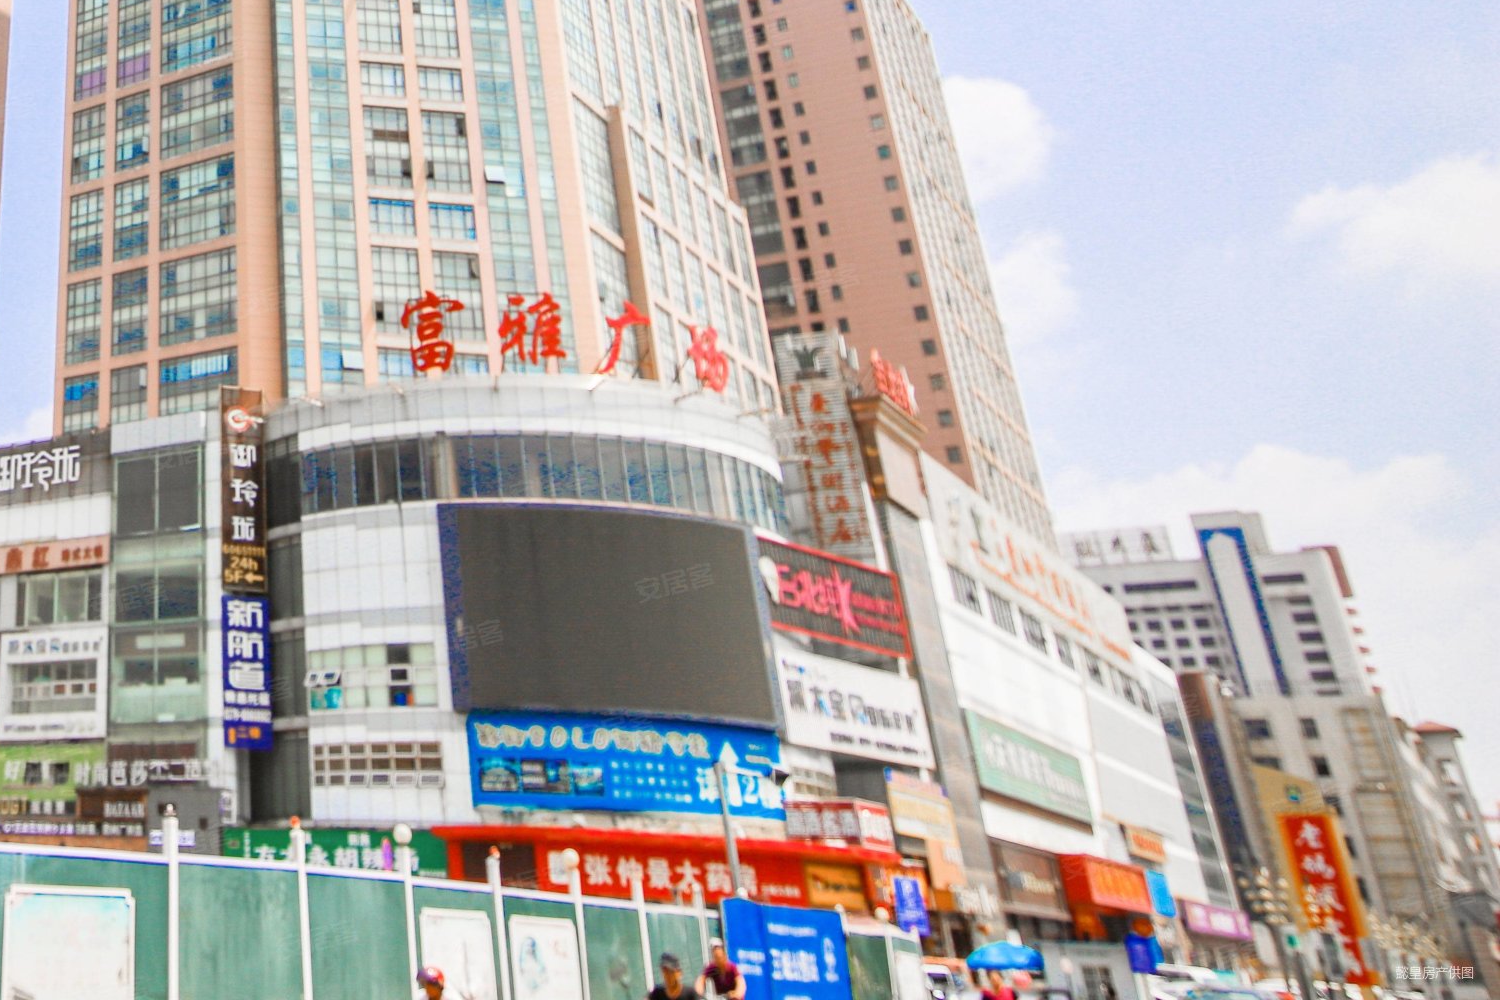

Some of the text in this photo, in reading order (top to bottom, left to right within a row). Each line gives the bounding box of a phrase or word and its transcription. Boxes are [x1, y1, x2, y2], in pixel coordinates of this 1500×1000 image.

[401, 289, 729, 394] 富雅广场
[229, 555, 259, 572] 24h
[226, 599, 266, 691] 新航道
[583, 853, 758, 896] 张仲景大药房
